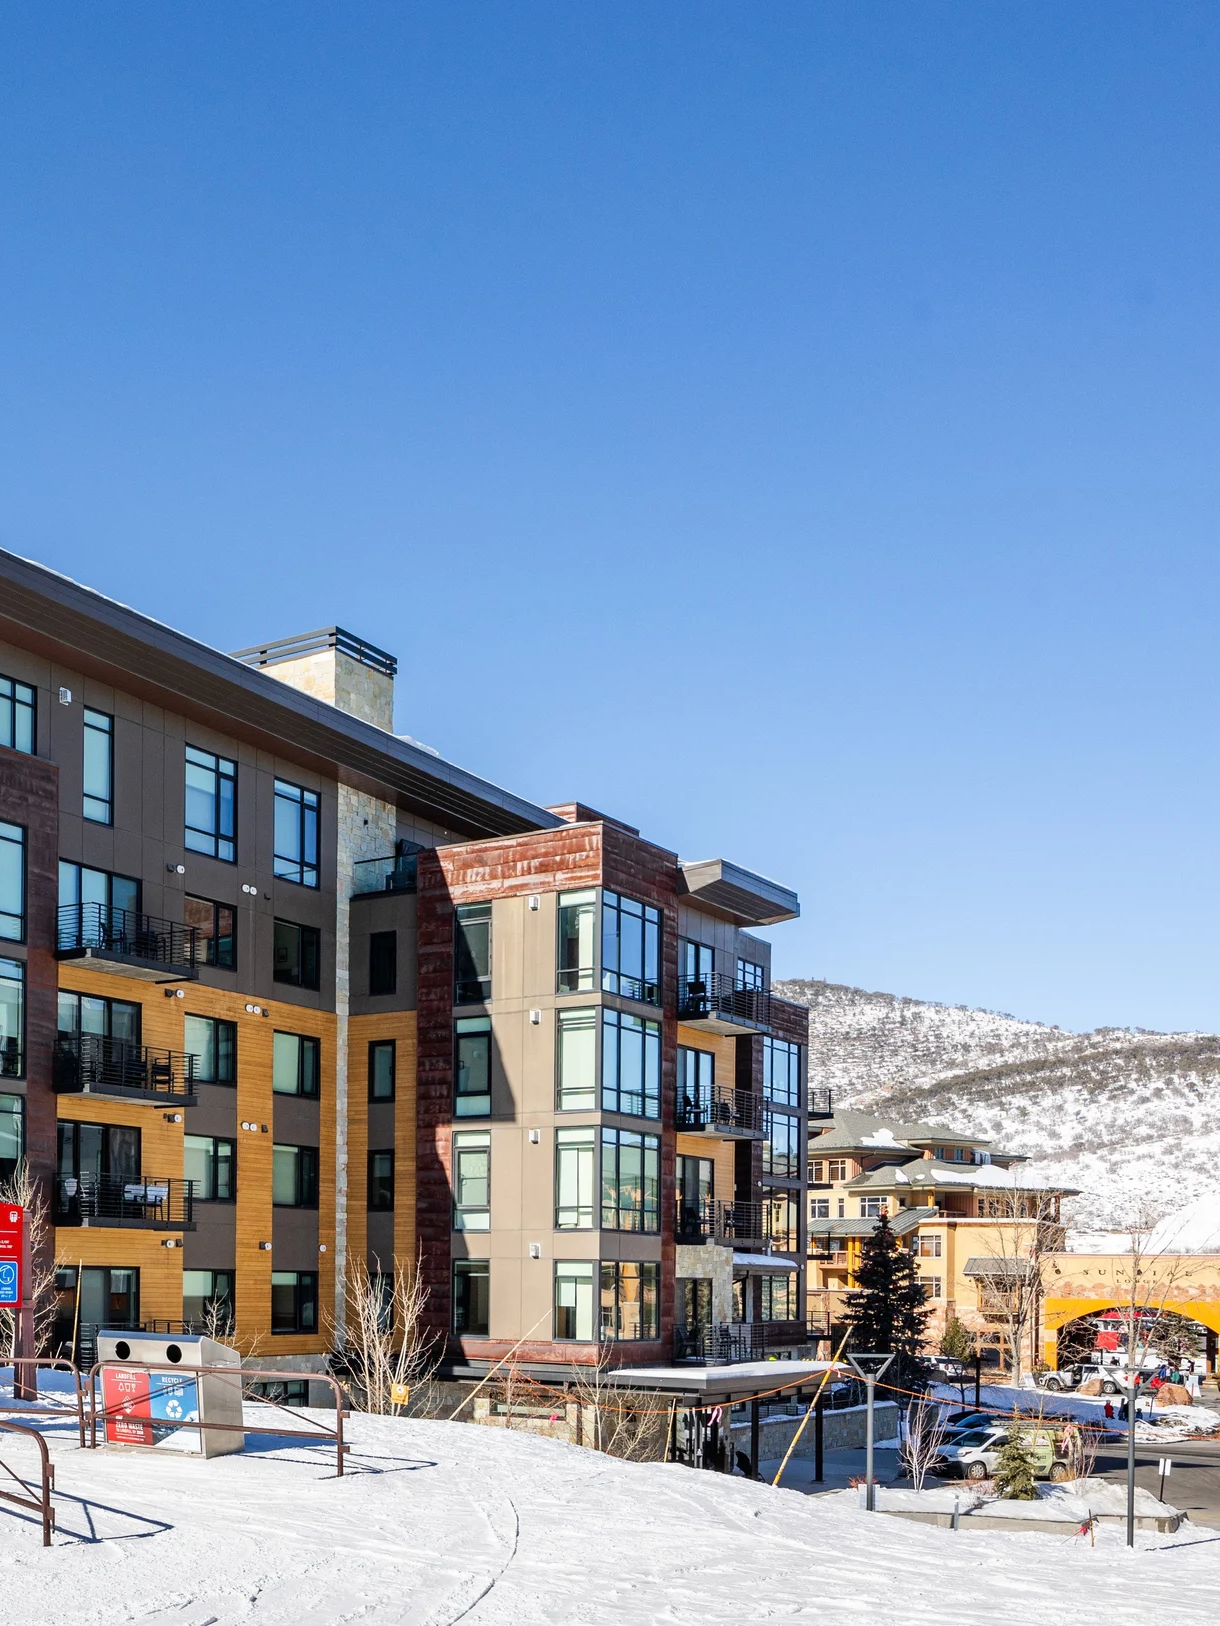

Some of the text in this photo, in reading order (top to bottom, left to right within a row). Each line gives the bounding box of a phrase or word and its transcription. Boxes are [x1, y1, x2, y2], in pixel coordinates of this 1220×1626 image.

[161, 1376, 183, 1384] RECYCLE
[115, 1421, 144, 1431] ZERO WASTE
